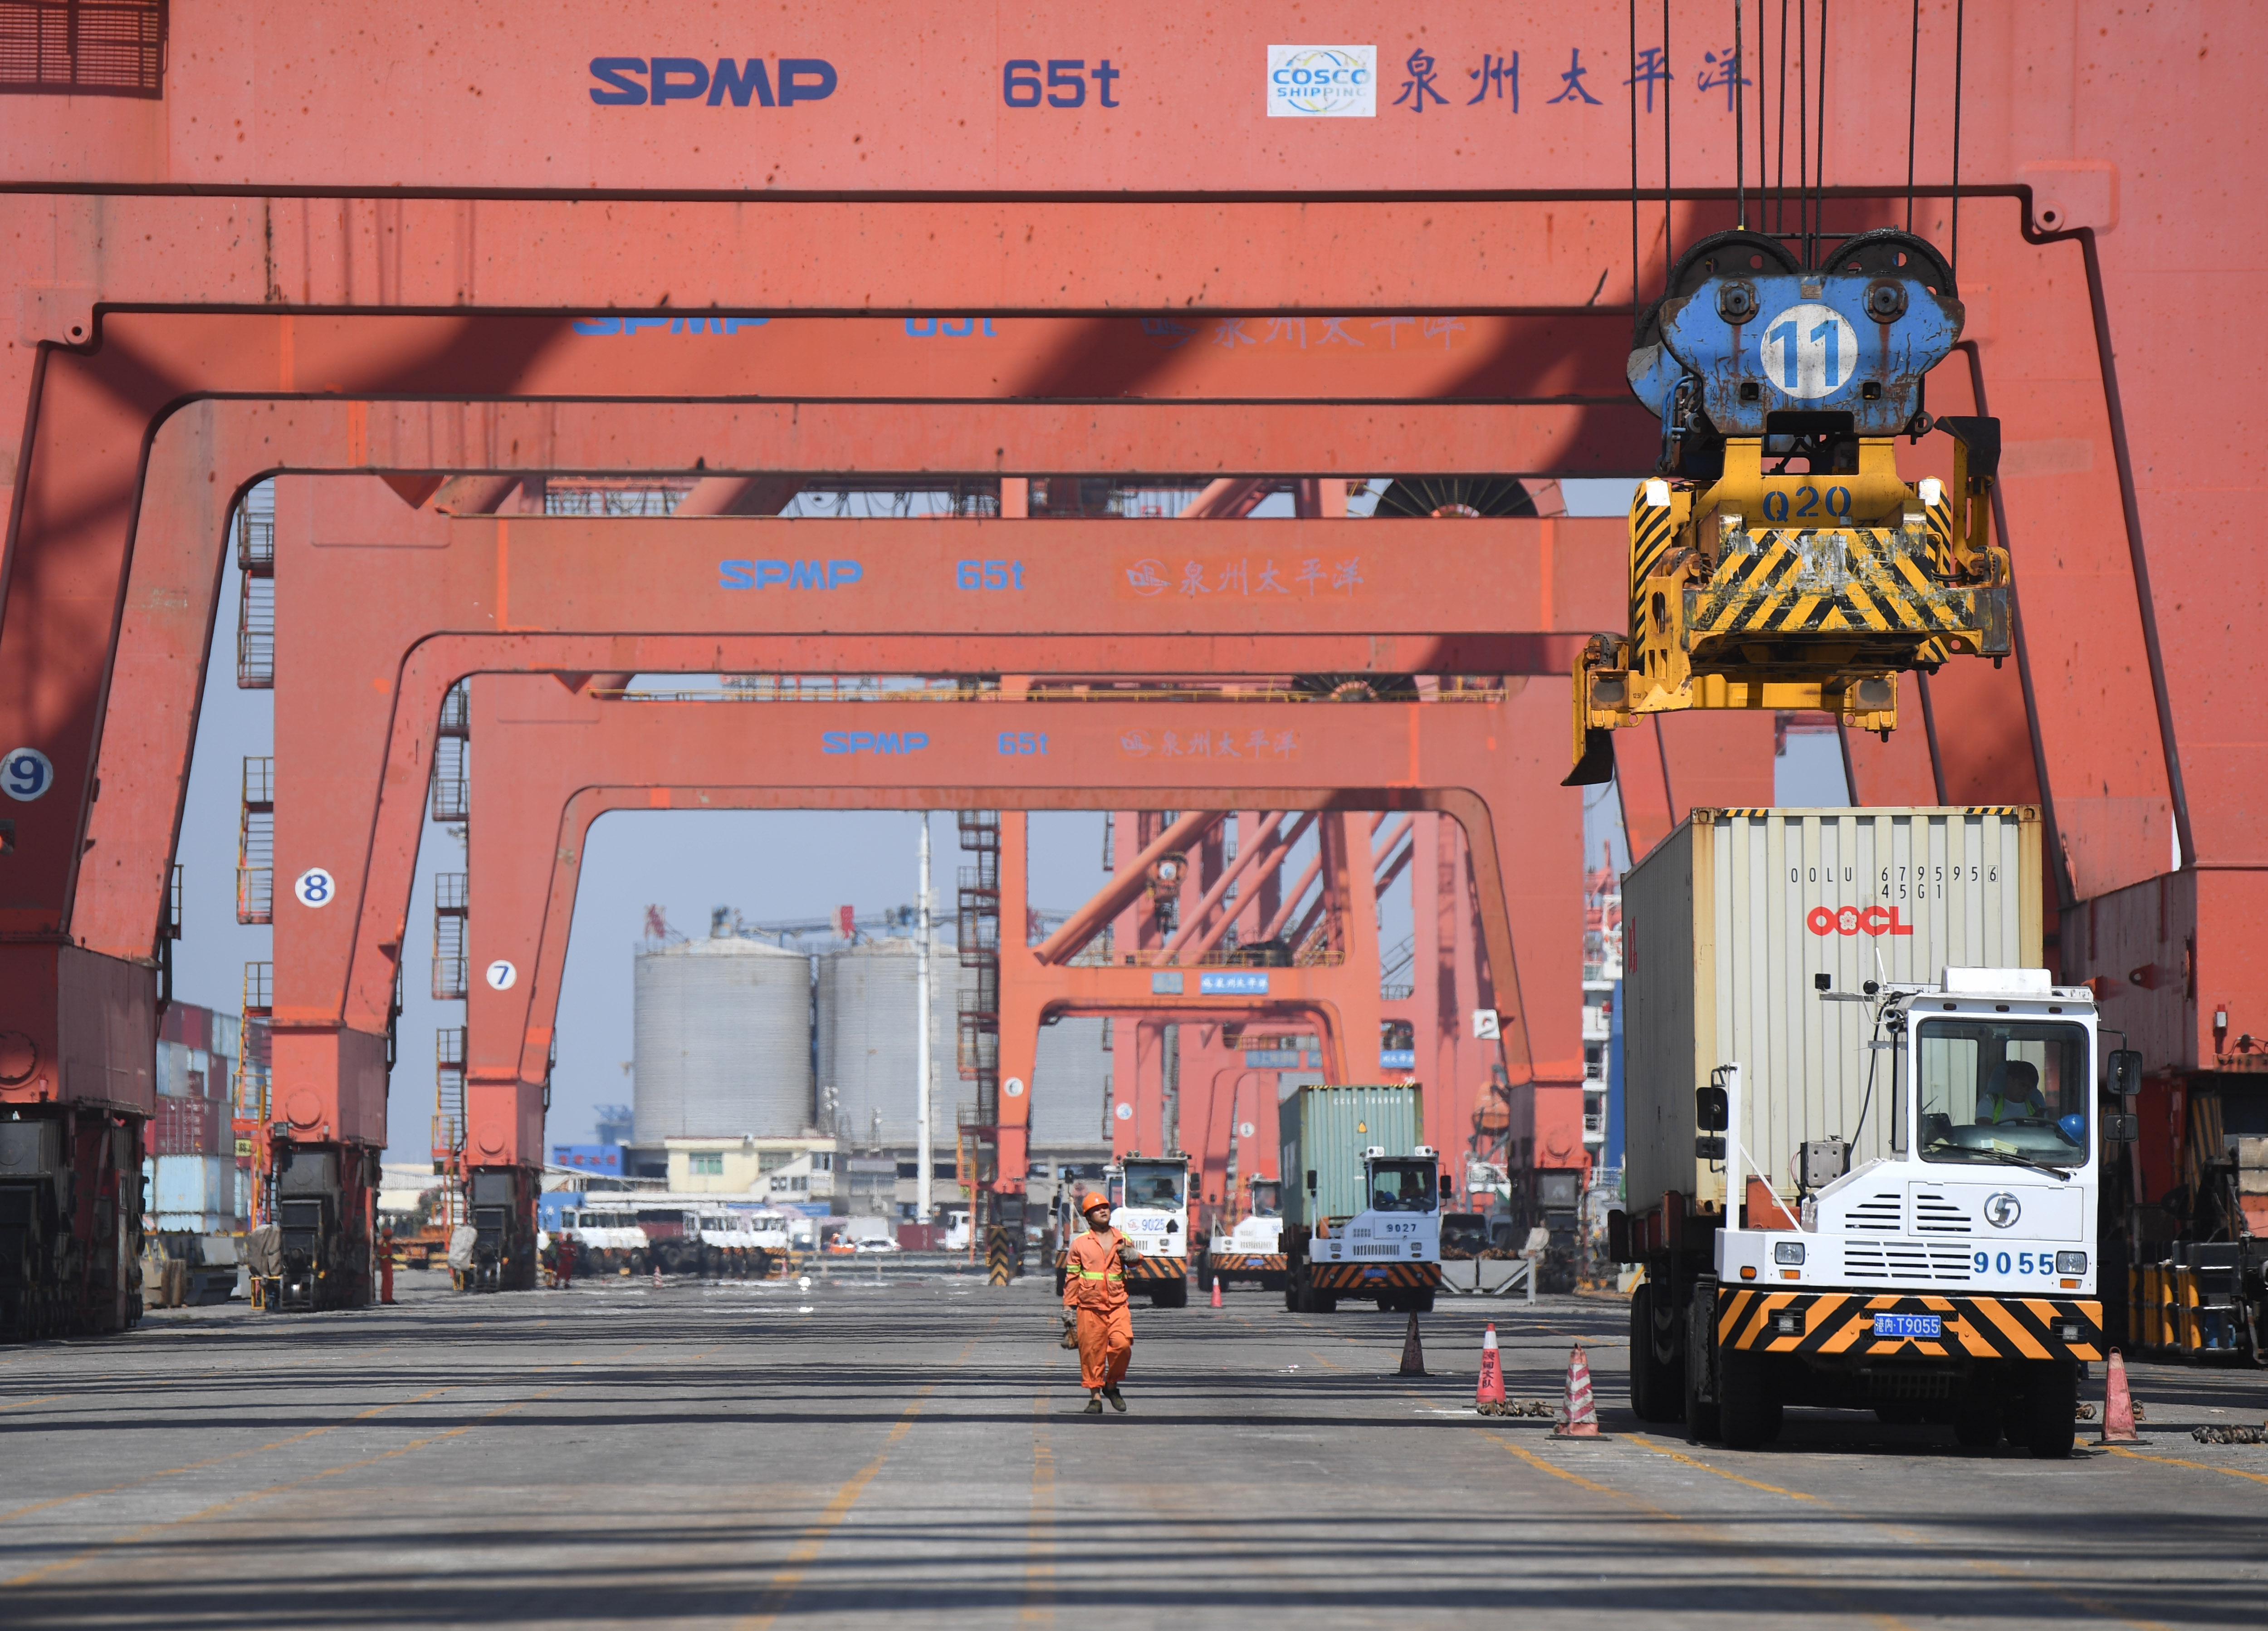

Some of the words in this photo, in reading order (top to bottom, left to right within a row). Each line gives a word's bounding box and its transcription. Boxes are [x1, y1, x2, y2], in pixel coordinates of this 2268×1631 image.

[589, 57, 837, 107] SPMP
[1003, 59, 1119, 108] 65t
[1273, 69, 1371, 85] COSCO
[1392, 46, 1753, 113] 泉州太平洋
[1769, 319, 1839, 388] 11
[1763, 486, 1852, 522] Q20
[719, 559, 863, 590] SPMP
[957, 560, 1025, 590] 65t
[1180, 556, 1364, 596] 泉州太平洋
[822, 731, 929, 754] SPMP
[998, 732, 1049, 754] 65t
[1162, 729, 1297, 759] 泉州太平洋
[10, 756, 44, 794] 9
[304, 874, 328, 901] 8
[1791, 867, 1852, 883] OOLU
[1881, 884, 1941, 899] 45G1
[1807, 905, 1913, 936] OOCL
[494, 965, 508, 984] 7
[1142, 1218, 1165, 1231] 9025
[1386, 1223, 1417, 1232] 9027
[1974, 1251, 2054, 1275] 9055
